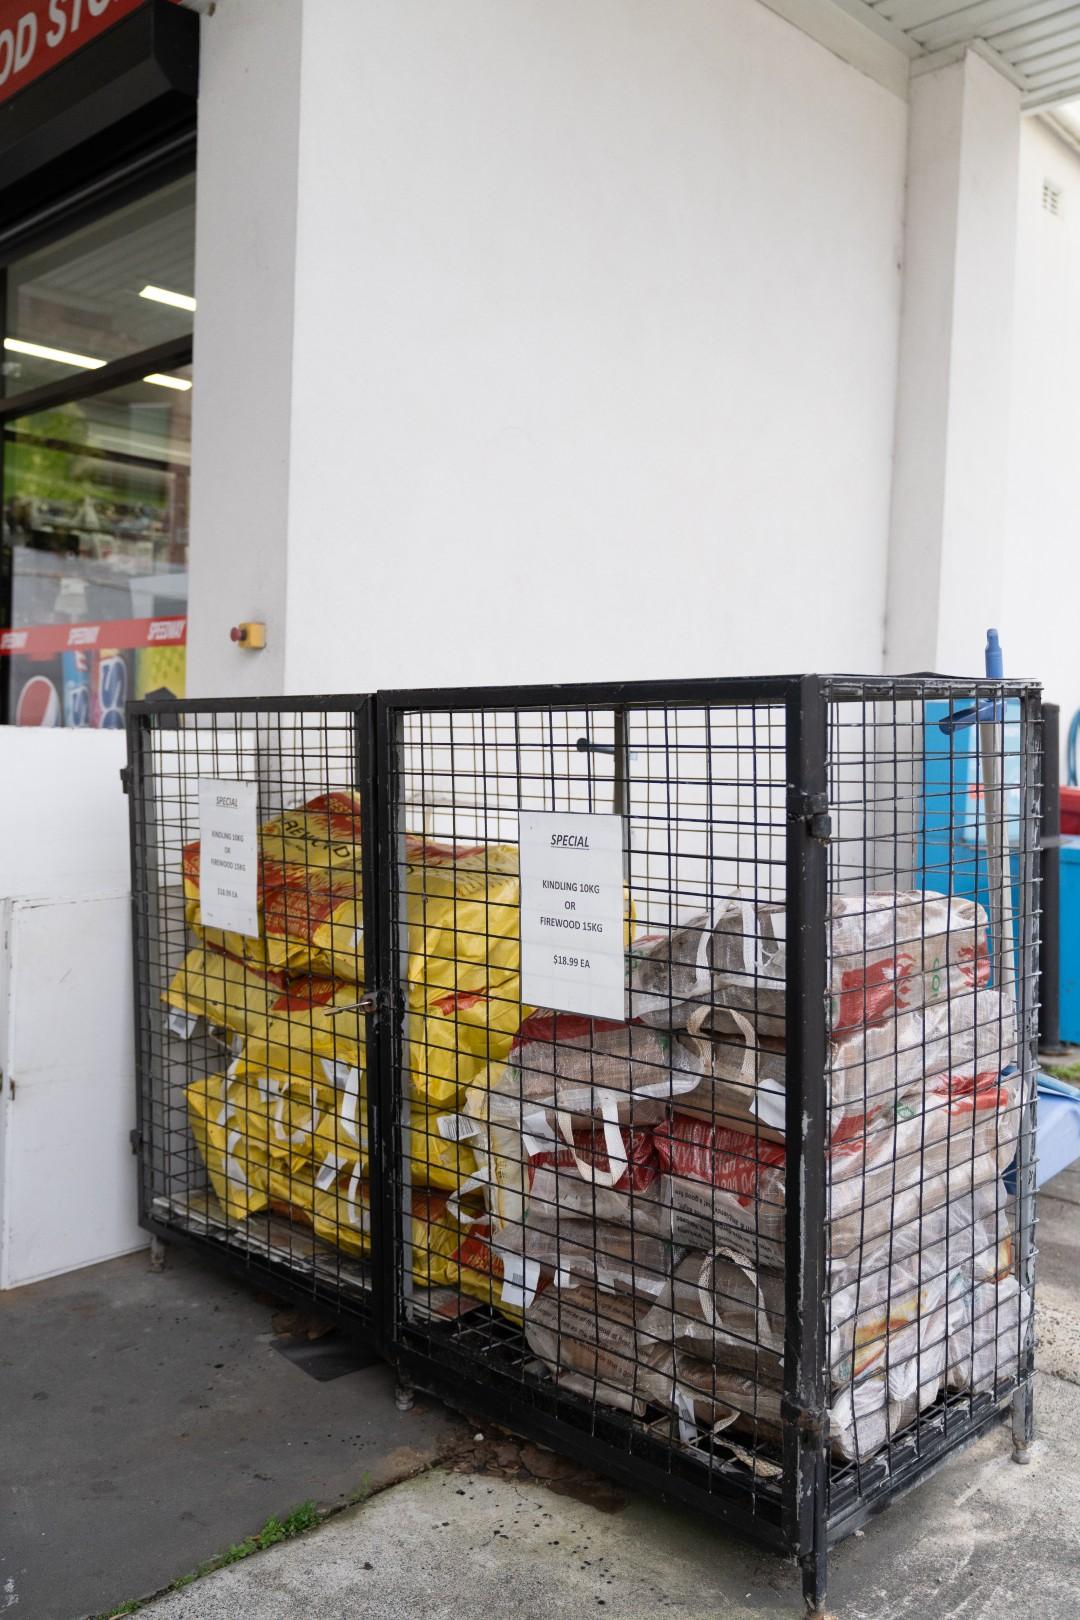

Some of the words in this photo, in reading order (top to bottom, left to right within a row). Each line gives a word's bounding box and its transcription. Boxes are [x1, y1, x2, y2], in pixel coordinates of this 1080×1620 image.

[215, 796, 238, 808] SPECIAL
[550, 834, 590, 848] SPECIAL
[542, 880, 578, 892] KINDLING
[579, 883, 600, 894] 10KG
[564, 900, 576, 910] OR
[540, 916, 581, 930] FIREWOOD
[582, 922, 603, 933] 15KG
[553, 955, 579, 967] $18.99
[580, 959, 591, 969] EA
